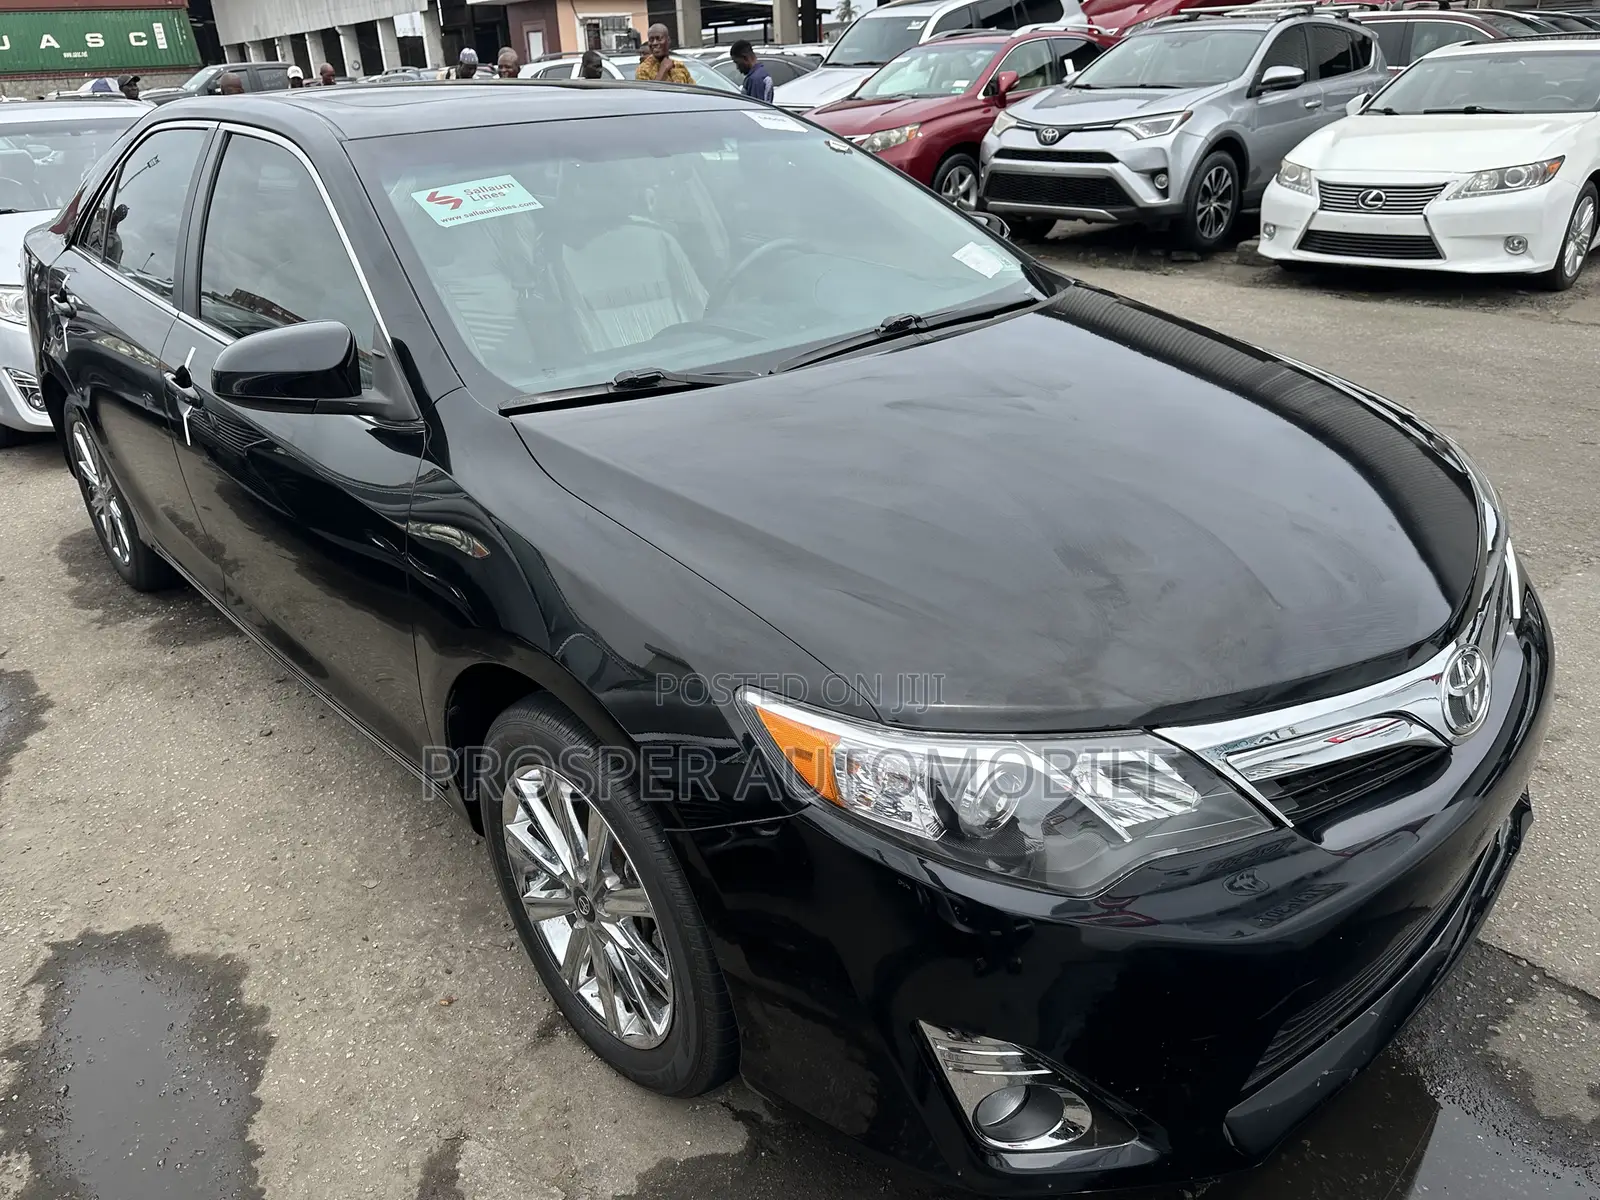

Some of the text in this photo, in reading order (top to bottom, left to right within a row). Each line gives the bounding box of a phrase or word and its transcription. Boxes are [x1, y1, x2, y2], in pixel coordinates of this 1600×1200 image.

[463, 182, 515, 196] Sallaum
[469, 190, 506, 202] Lines
[440, 201, 537, 222] wwwsallaumlines.com
